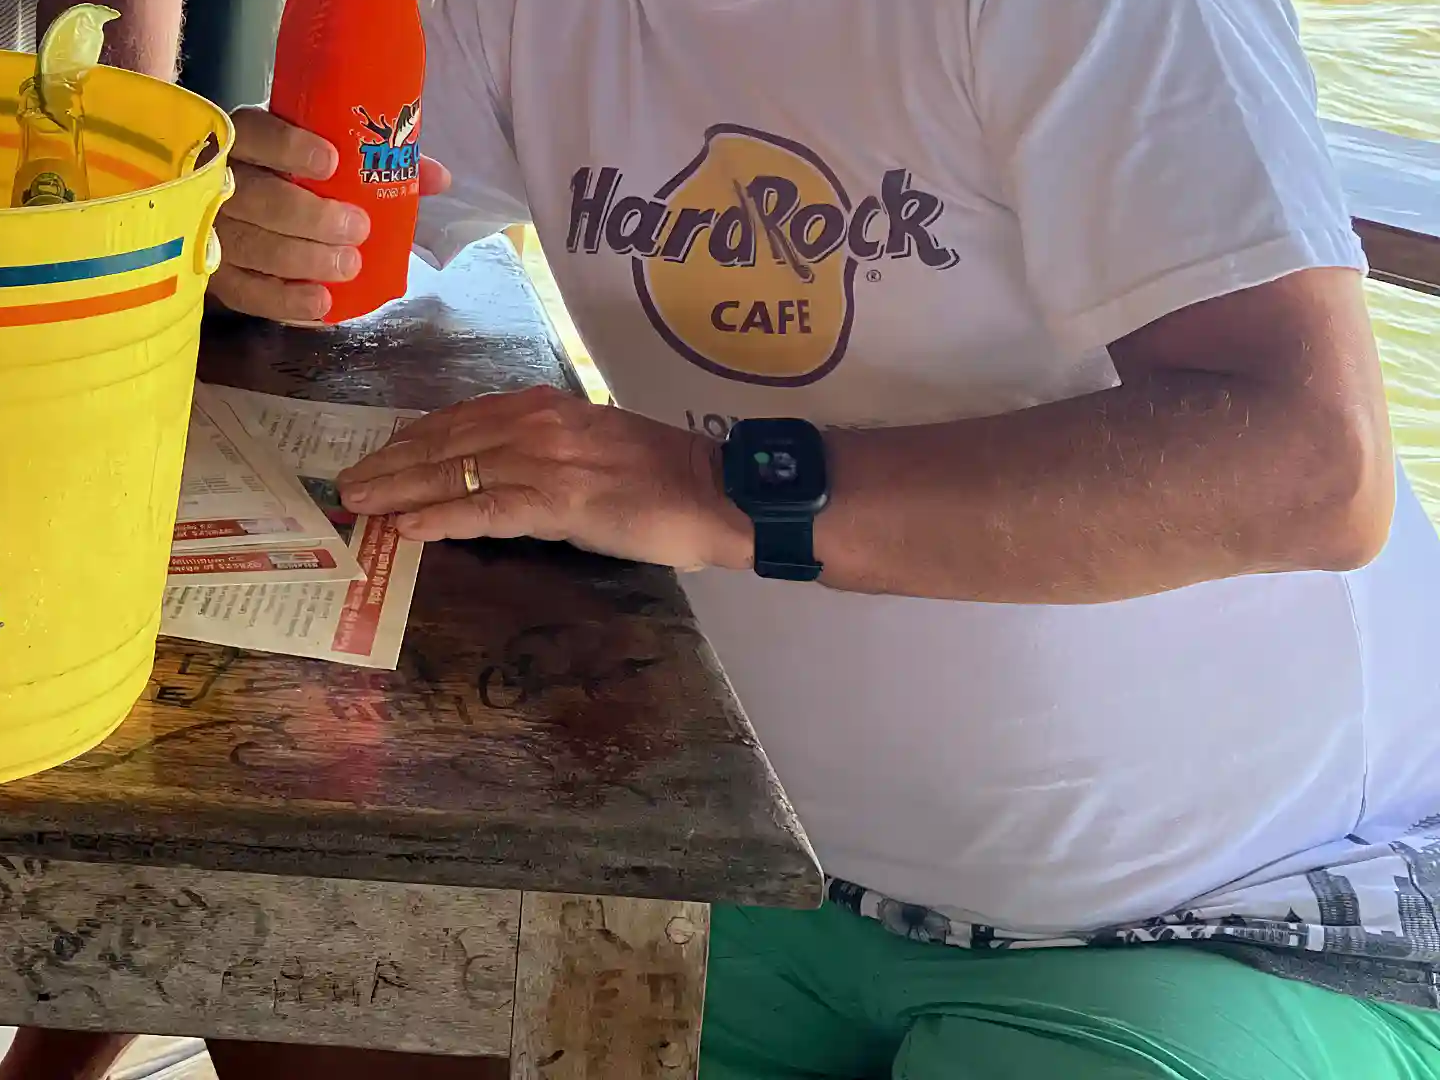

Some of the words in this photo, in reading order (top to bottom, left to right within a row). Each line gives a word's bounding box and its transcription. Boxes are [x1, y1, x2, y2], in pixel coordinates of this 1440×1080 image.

[565, 166, 757, 268] Hard
[746, 167, 960, 284] Rock
[710, 300, 813, 335] CAFE
